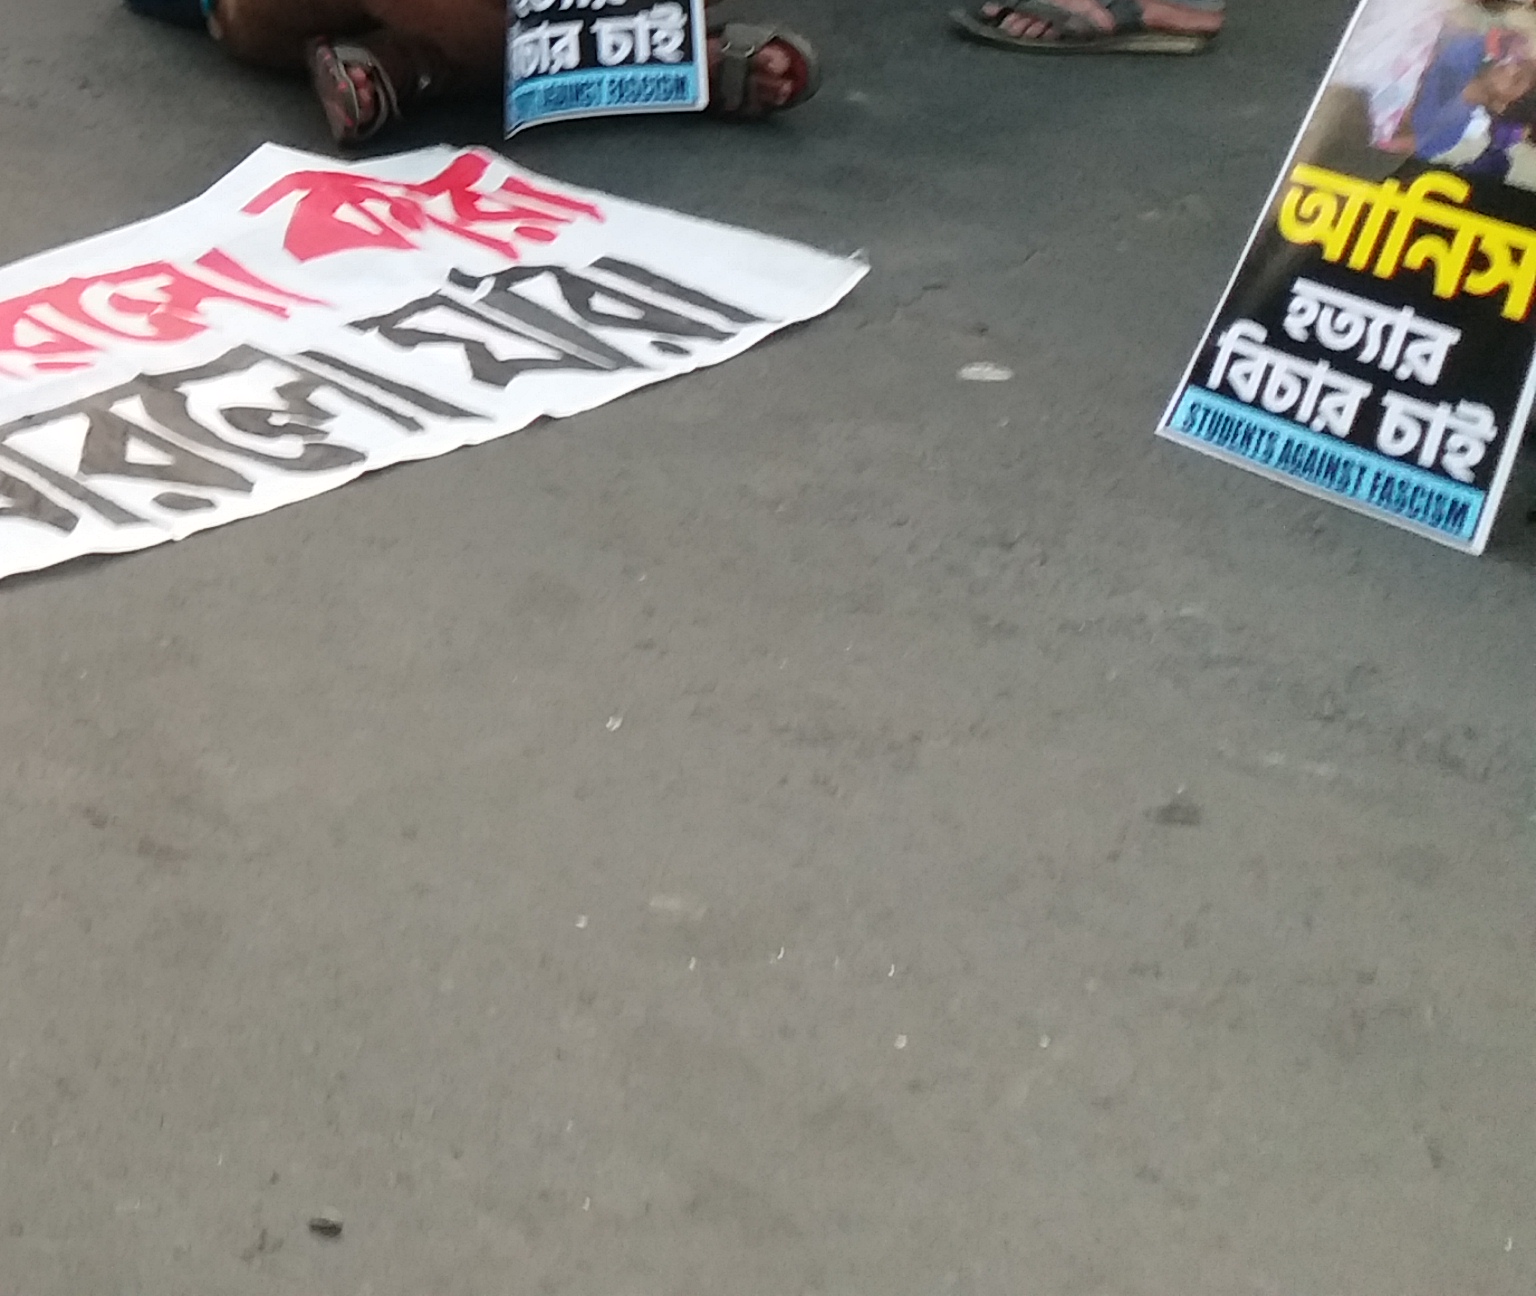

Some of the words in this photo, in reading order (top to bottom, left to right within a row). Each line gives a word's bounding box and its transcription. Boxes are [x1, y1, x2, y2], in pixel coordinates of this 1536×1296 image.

[589, 2, 689, 67] চাই
[240, 149, 608, 264] কারা
[1276, 161, 1536, 322] আনিস
[343, 255, 784, 390] যারা
[1284, 276, 1462, 386] হত্যার
[1181, 400, 1280, 467] STUDENTS
[1277, 435, 1368, 499] AGAINST
[1207, 316, 1374, 440] বিচার
[1376, 387, 1498, 484] চাই
